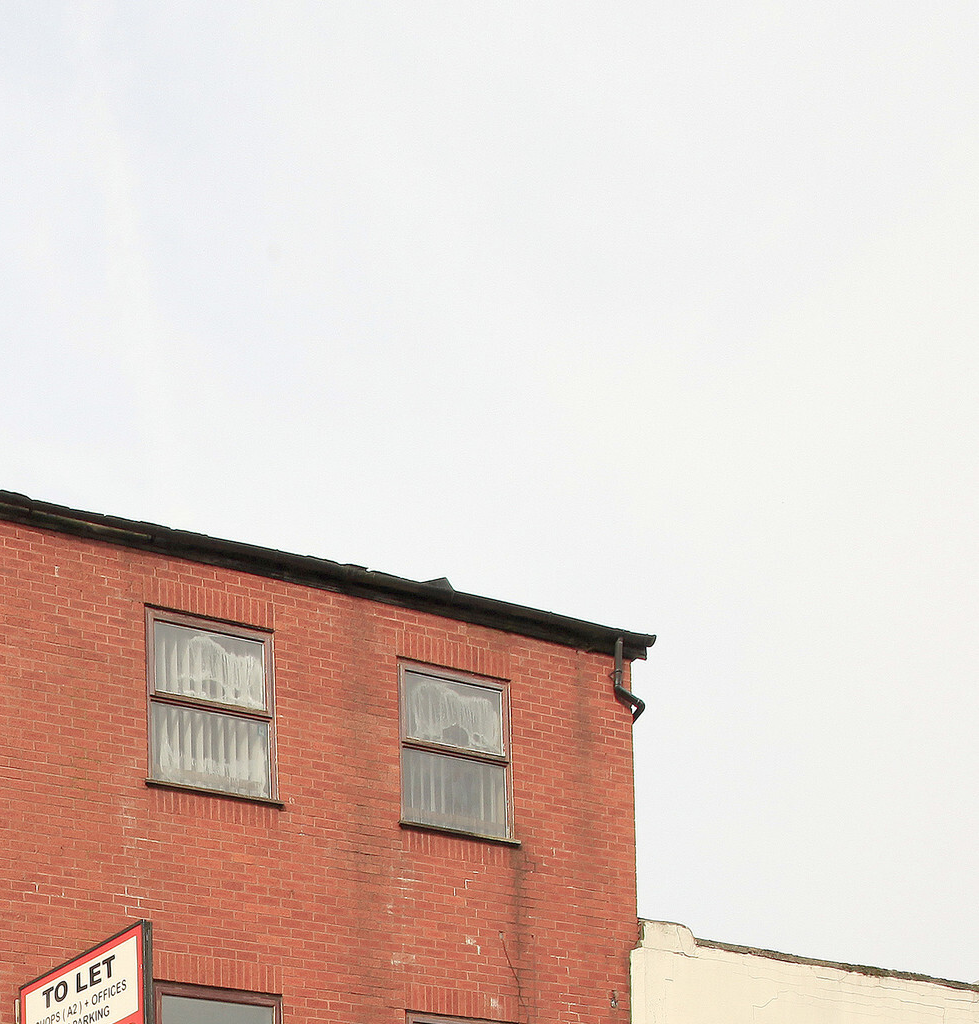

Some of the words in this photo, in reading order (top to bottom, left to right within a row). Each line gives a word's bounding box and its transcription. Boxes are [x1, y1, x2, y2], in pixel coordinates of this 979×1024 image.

[42, 980, 68, 1009] TO
[76, 954, 116, 993] LET
[91, 979, 127, 1007] OFFICES
